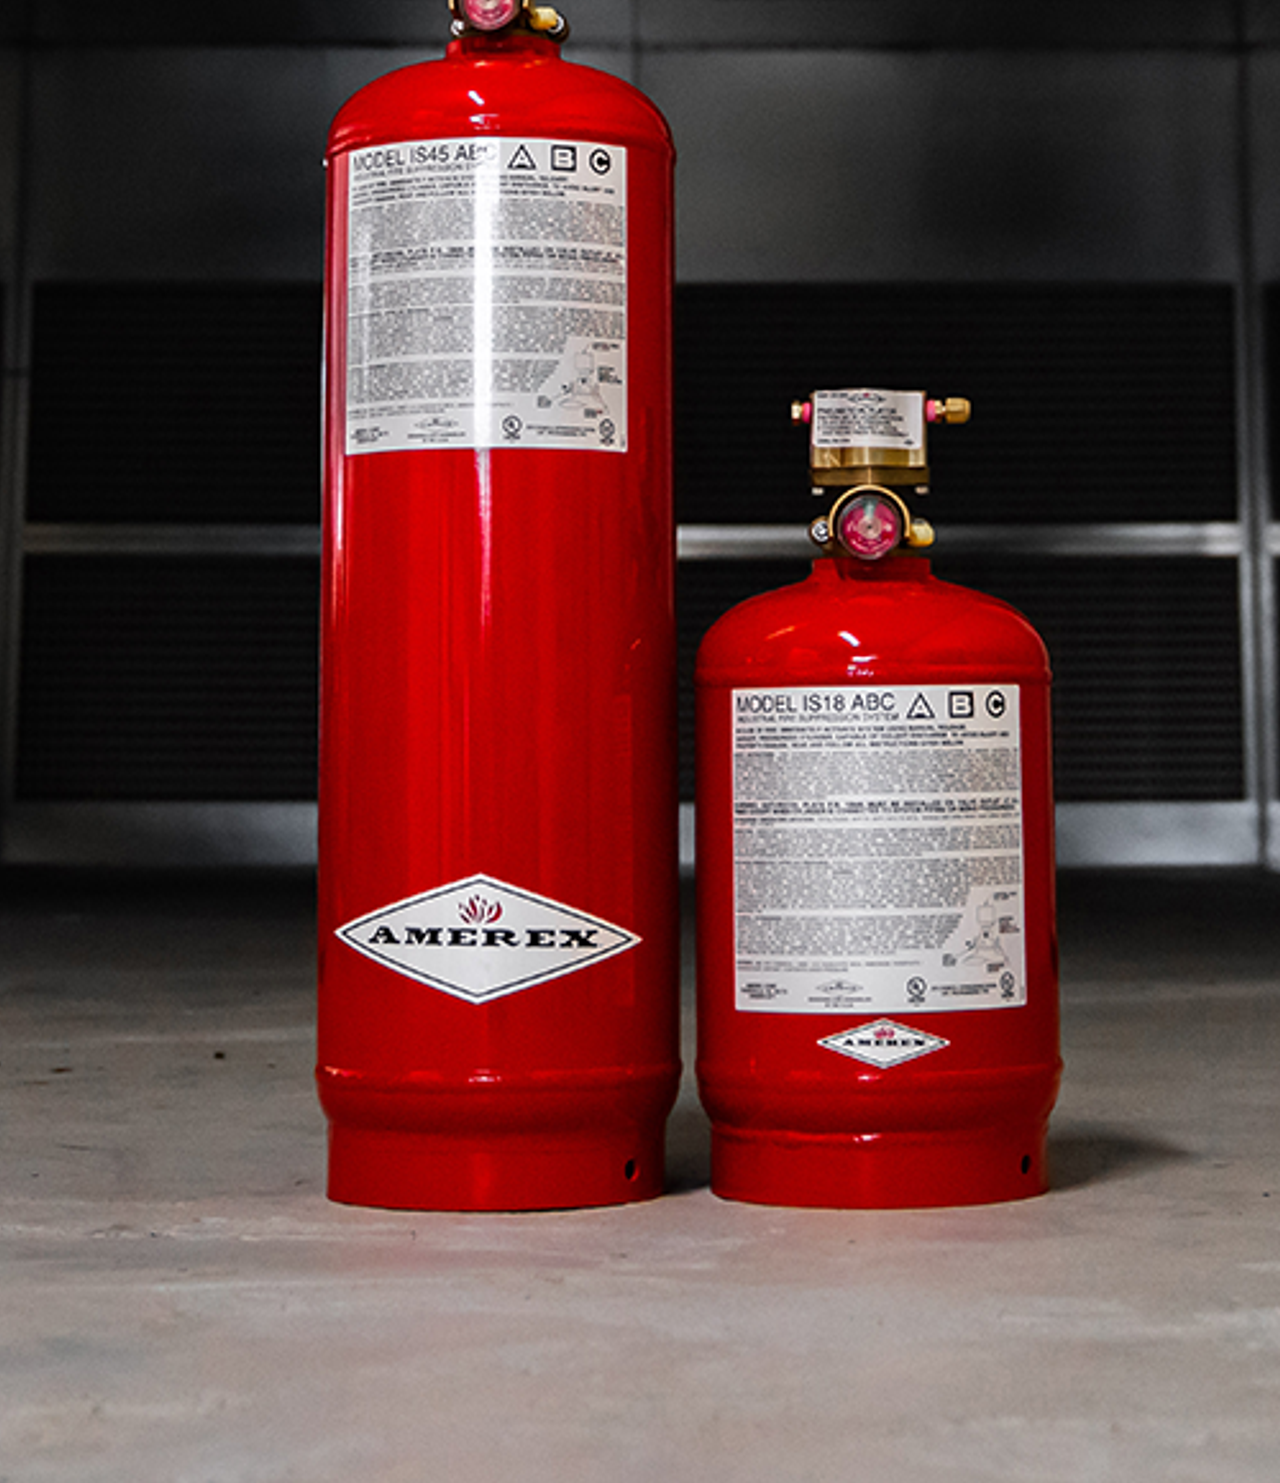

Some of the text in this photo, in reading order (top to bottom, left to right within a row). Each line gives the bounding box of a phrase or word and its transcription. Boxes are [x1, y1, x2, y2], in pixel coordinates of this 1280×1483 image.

[353, 148, 405, 172] MODEL
[410, 144, 449, 164] IS45
[590, 149, 610, 175] C
[737, 692, 896, 714] MODEL IS18 ABC
[985, 690, 1005, 718] C
[370, 926, 598, 948] AMEREX
[843, 1039, 925, 1047] AMEREX
